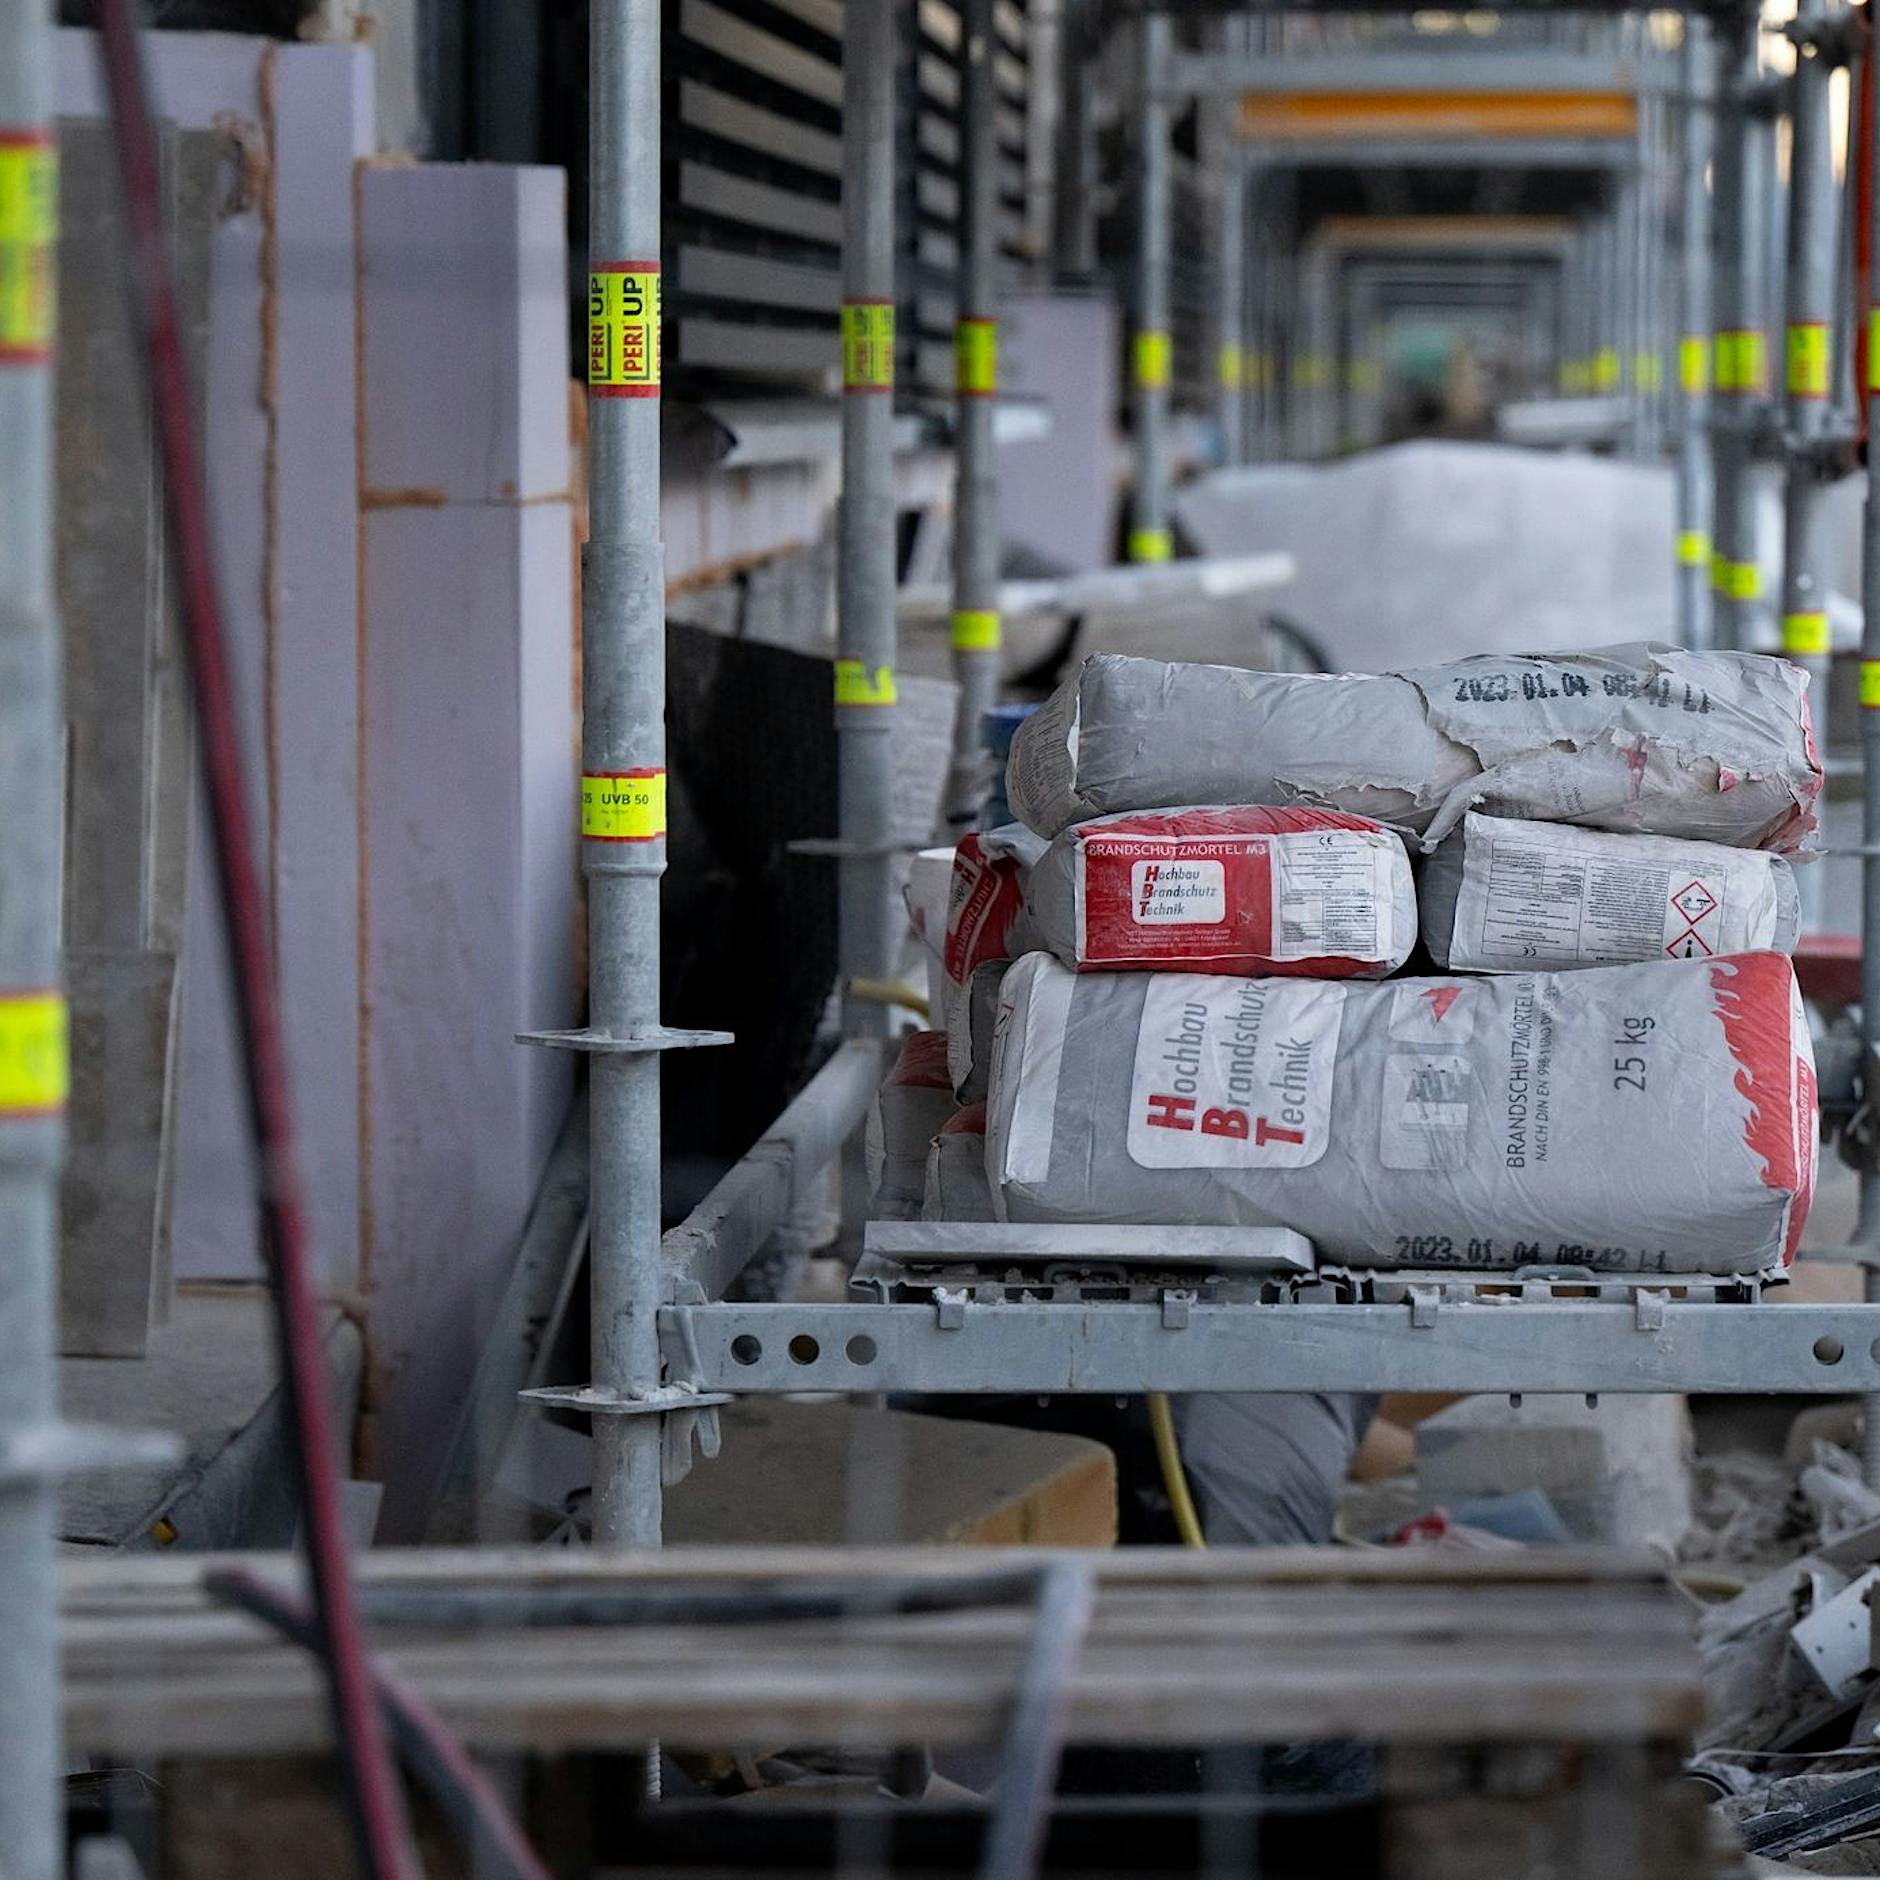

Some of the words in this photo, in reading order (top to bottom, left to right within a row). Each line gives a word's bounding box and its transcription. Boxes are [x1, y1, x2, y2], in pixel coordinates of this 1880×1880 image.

[591, 276, 604, 316] UP
[623, 276, 643, 316] UP
[591, 325, 604, 372] PERI
[623, 325, 643, 372] PERI
[602, 793, 631, 805] UVB
[634, 794, 649, 805] 50
[1246, 843, 1266, 855] M3
[1144, 865, 1200, 882] Hochbau
[1142, 883, 1217, 899] Brandschutz
[1139, 901, 1184, 917] Technik
[1614, 1016, 1656, 1045] kg
[1147, 1002, 1208, 1131] Hochbau
[1201, 981, 1269, 1140] Brandschutz
[1614, 1057, 1646, 1092] 25
[1255, 1037, 1313, 1147] Technik
[1537, 1078, 1550, 1097] EN
[1536, 1099, 1549, 1122] DIN
[1534, 1124, 1548, 1162] NACH
[1395, 1235, 1541, 1263] 2023.01.04
